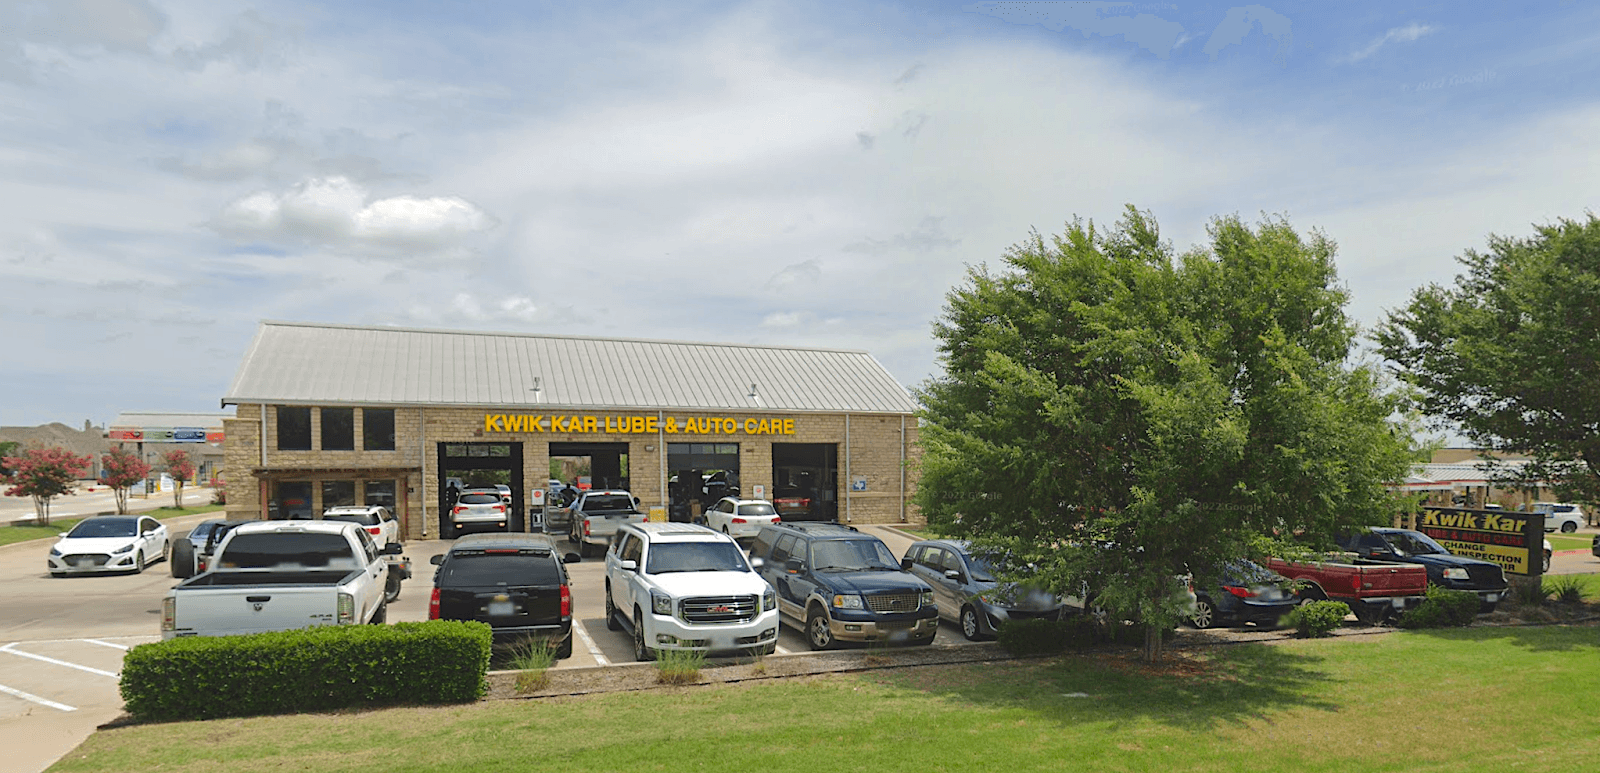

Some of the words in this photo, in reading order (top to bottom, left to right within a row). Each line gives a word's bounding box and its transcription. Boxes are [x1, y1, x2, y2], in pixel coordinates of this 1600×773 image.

[485, 414, 544, 432] KWIK
[551, 415, 598, 433] KAR
[605, 416, 659, 433] LUBE
[665, 416, 679, 434] &
[684, 417, 738, 434] AUTO
[744, 418, 796, 435] CARE
[1422, 509, 1478, 528] Kwik
[1482, 513, 1527, 532] Kar
[1444, 541, 1486, 552] CHANGE
[1458, 550, 1522, 564] INSPECTION
